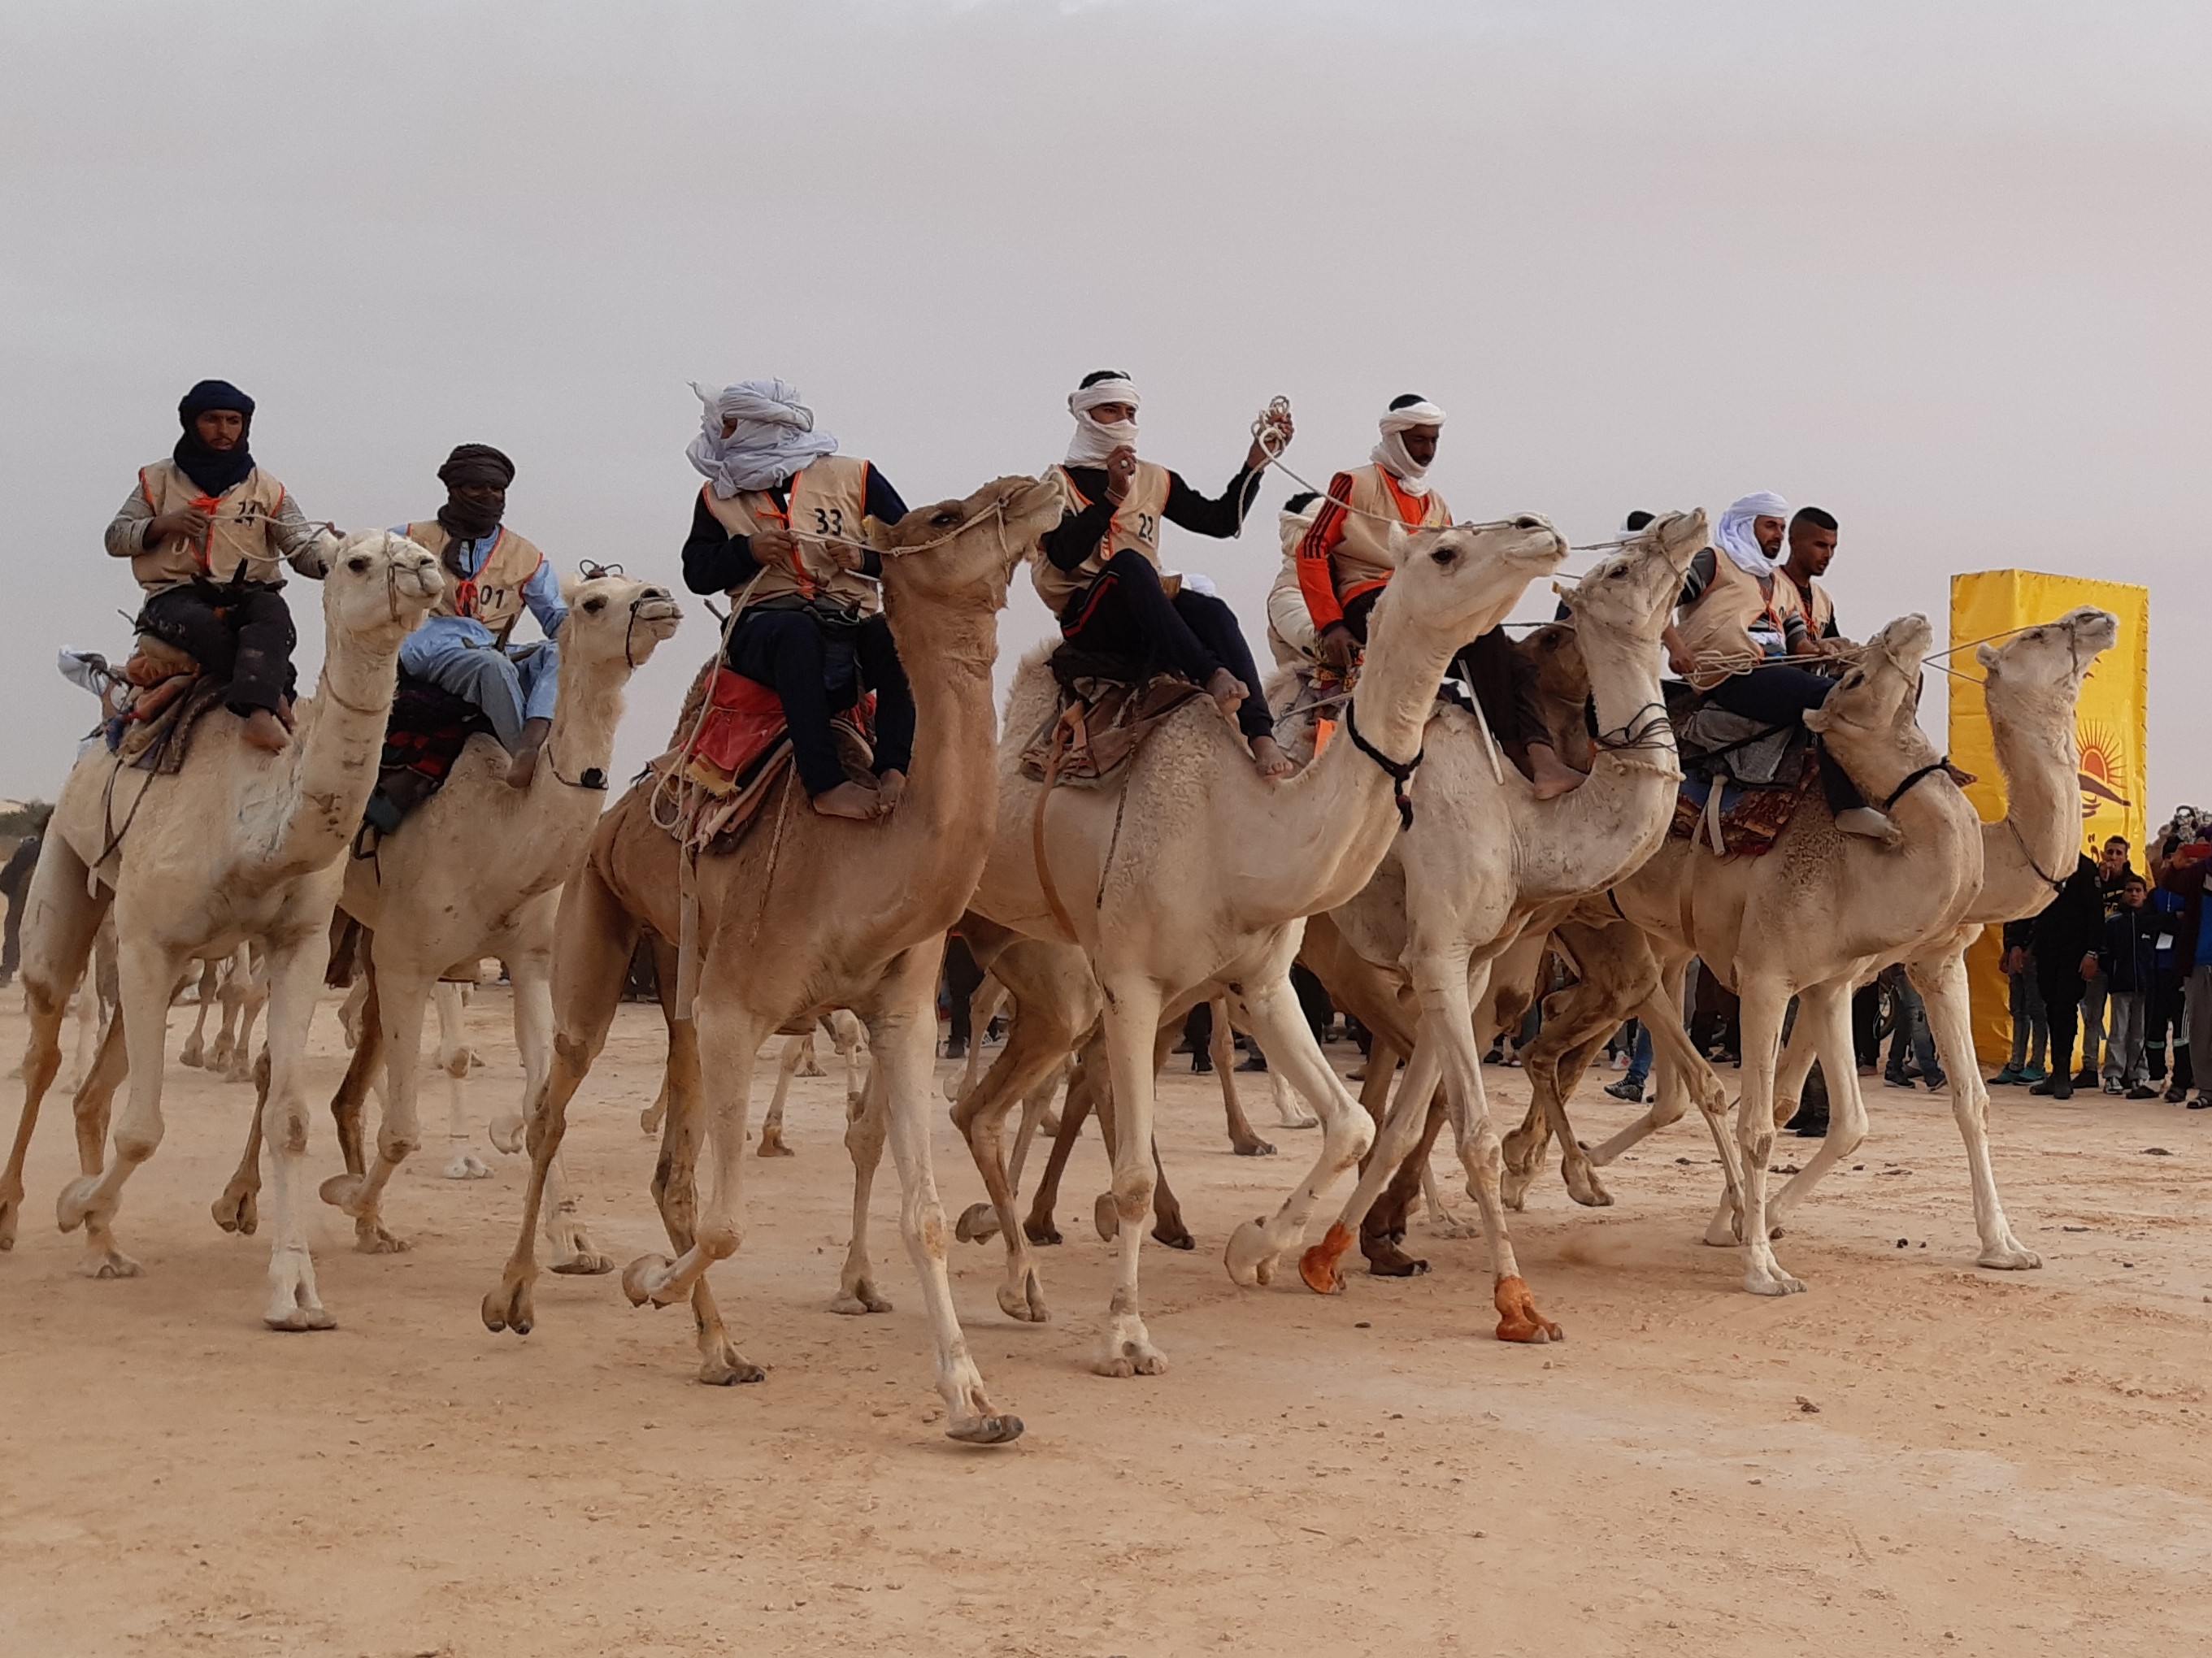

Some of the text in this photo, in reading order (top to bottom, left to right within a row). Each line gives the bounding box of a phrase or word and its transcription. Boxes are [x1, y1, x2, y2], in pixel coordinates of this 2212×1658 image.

[814, 508, 842, 536] 33
[1138, 512, 1154, 542] 22
[480, 585, 504, 609] 01
